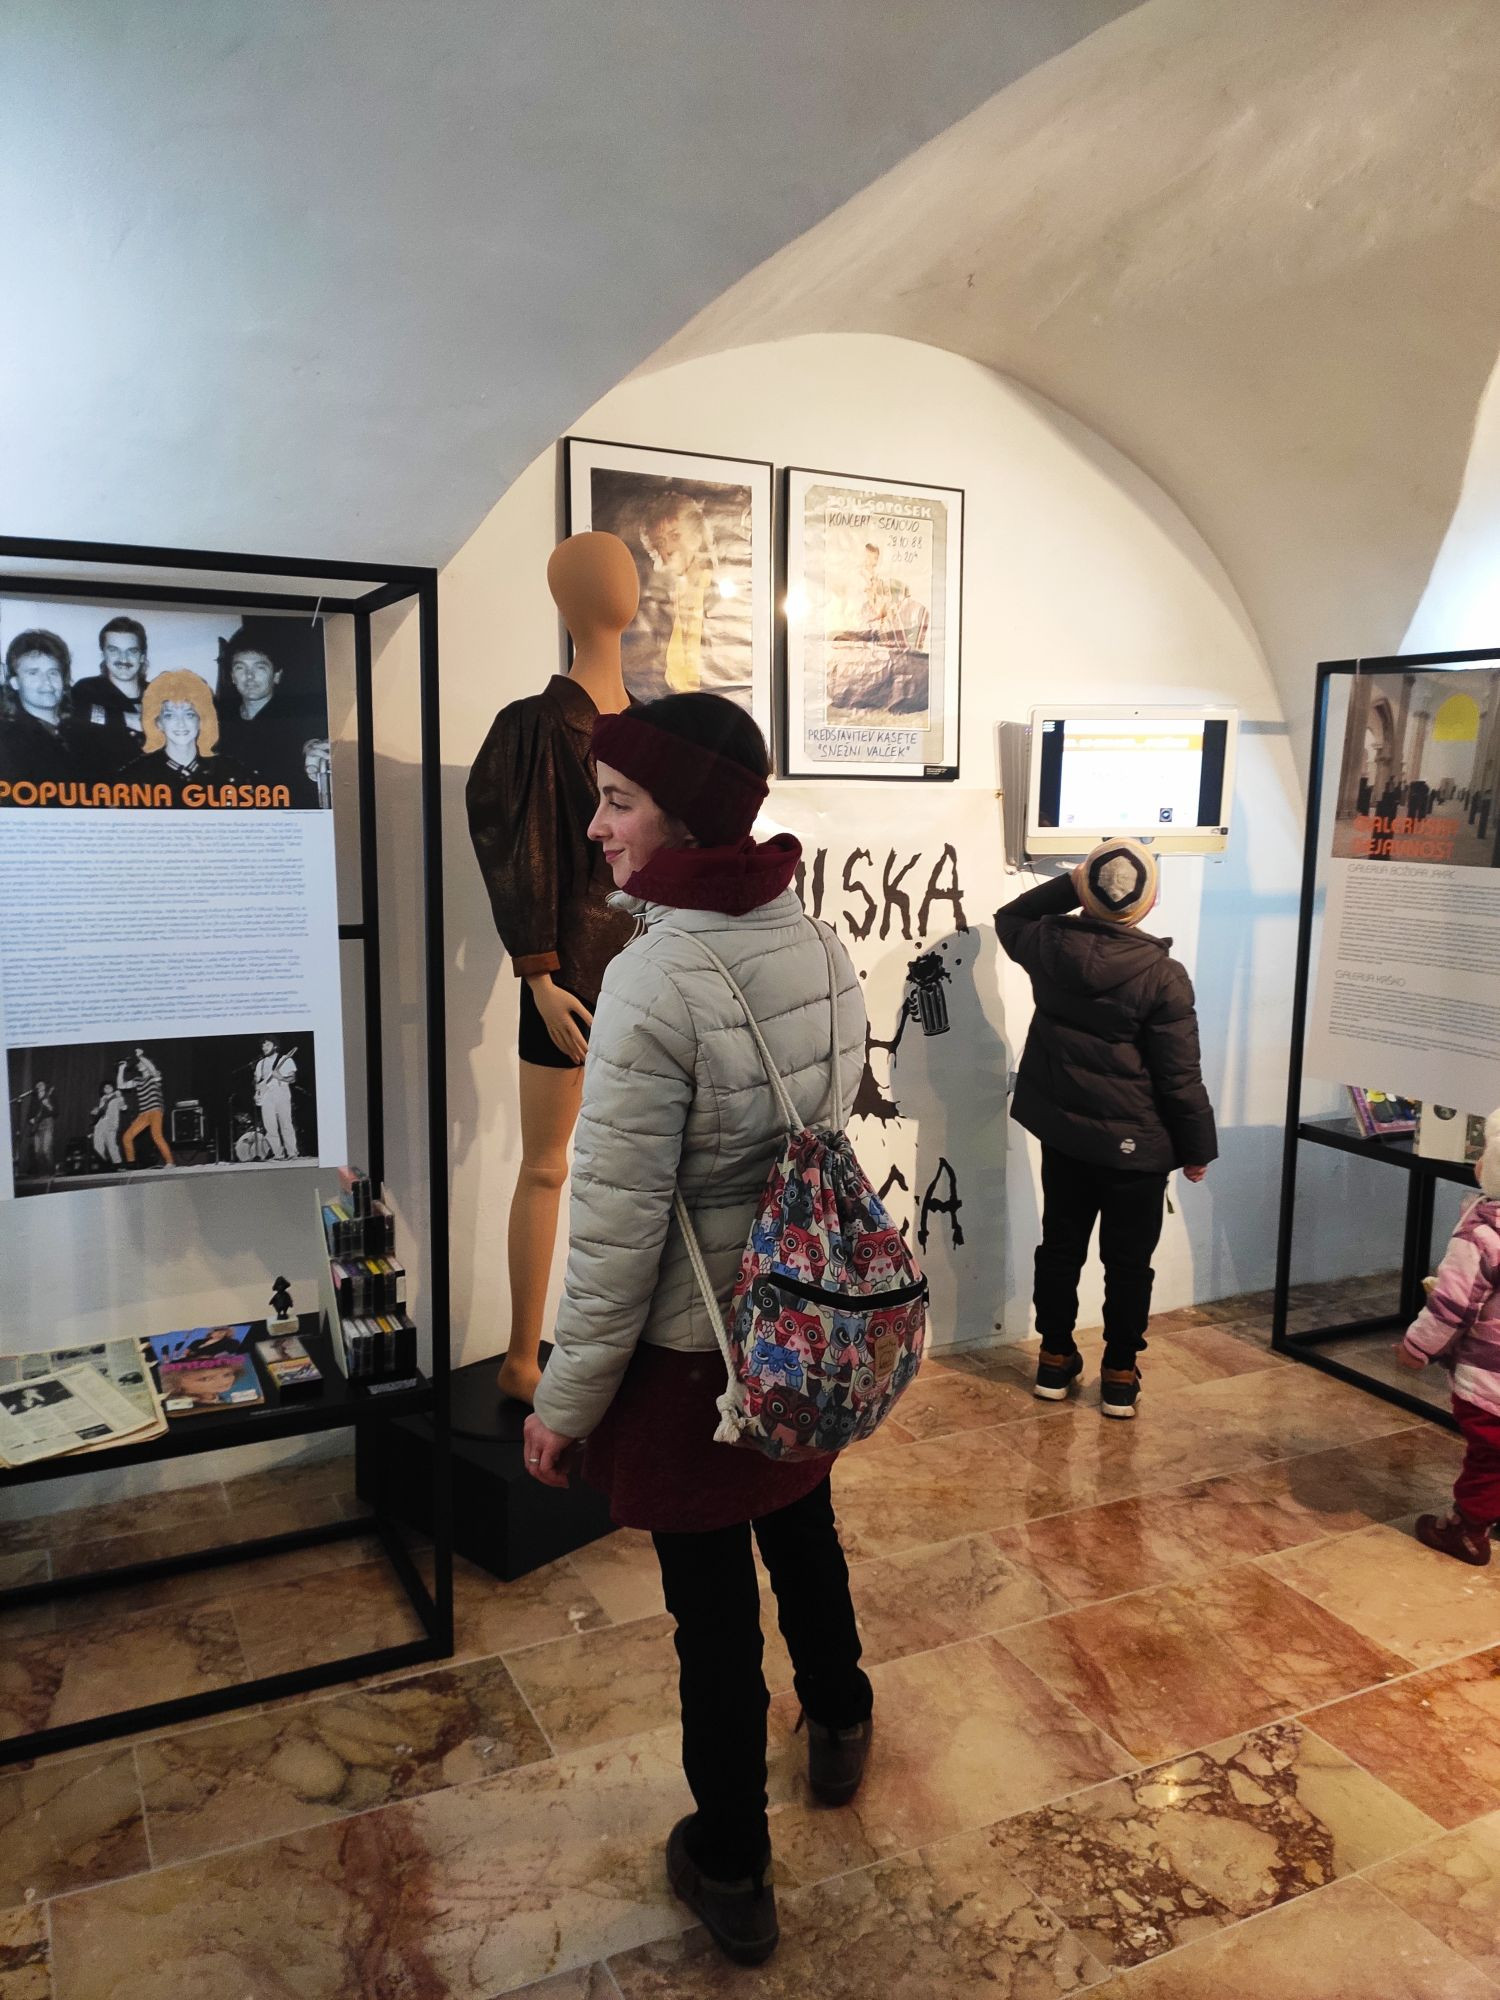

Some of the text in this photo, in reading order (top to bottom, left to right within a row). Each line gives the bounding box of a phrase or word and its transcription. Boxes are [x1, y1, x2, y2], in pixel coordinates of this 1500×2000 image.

[829, 512, 871, 528] KONCERT
[808, 728, 918, 745] PREDSTAVITEV KASETE
[0, 781, 290, 808] POPULARNA GLASBA
